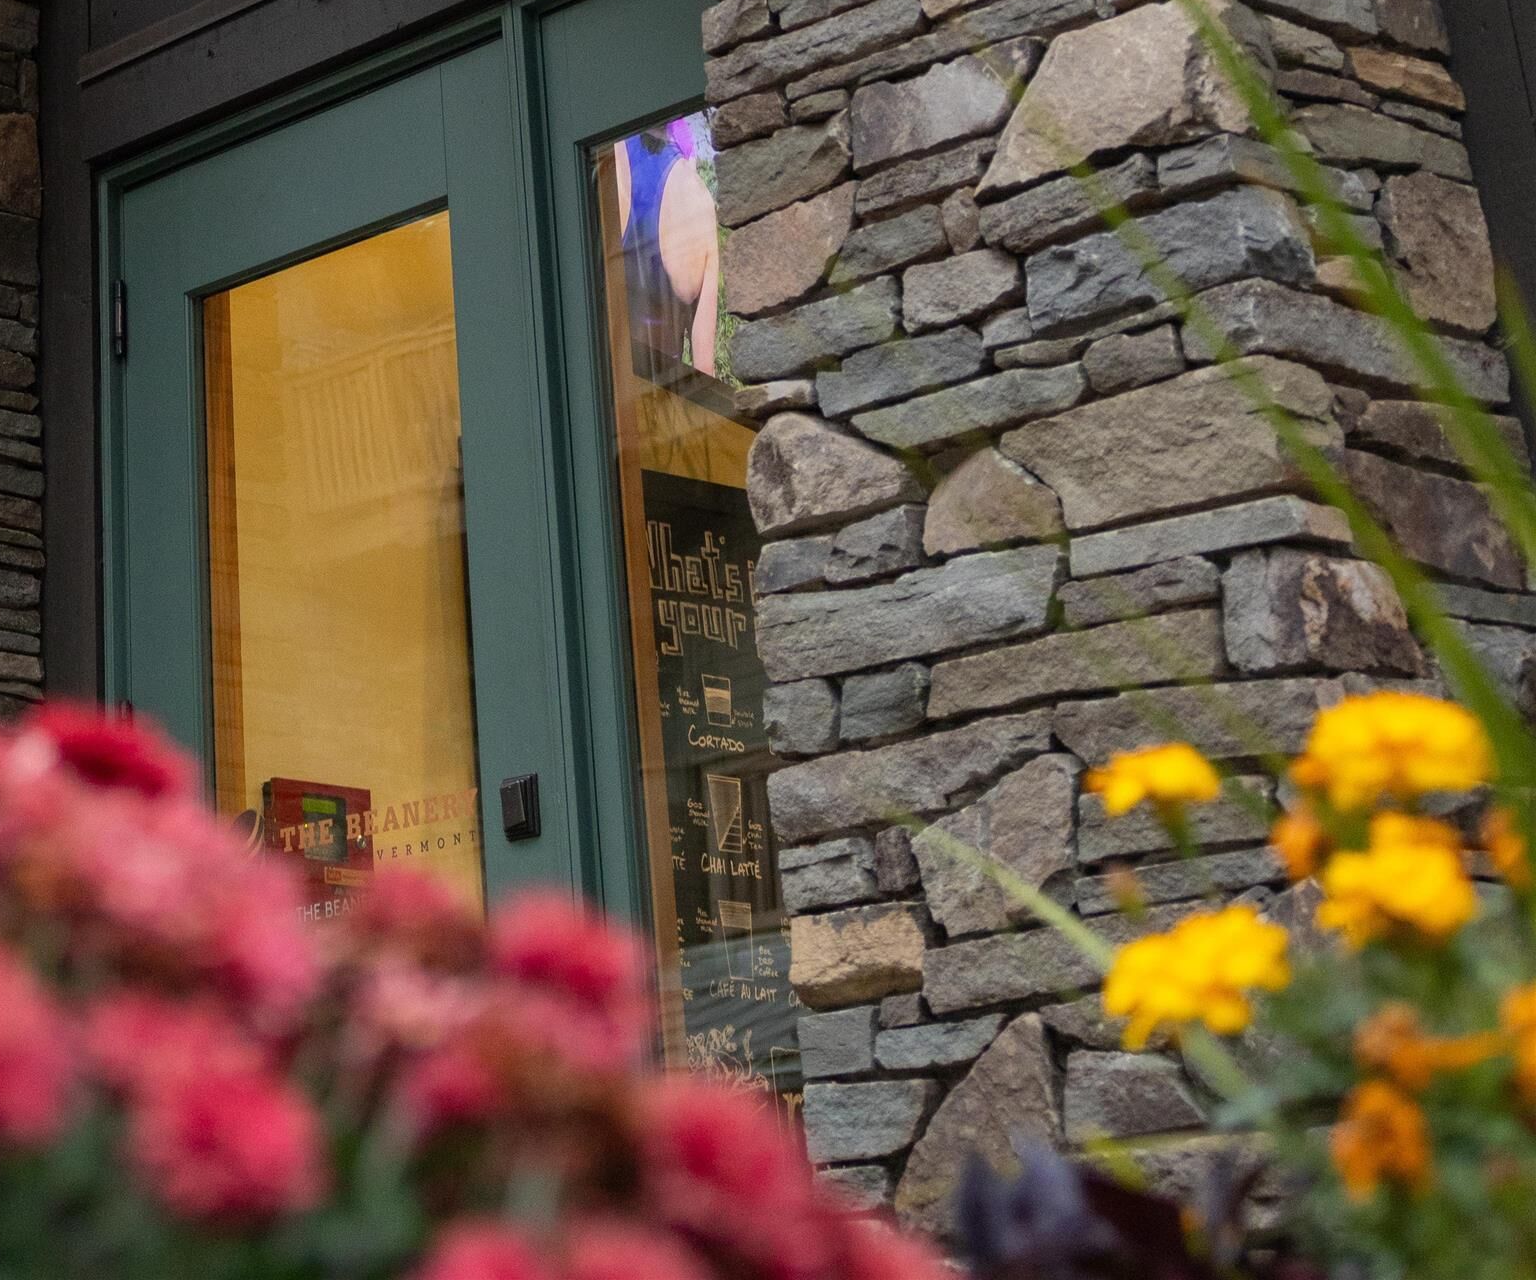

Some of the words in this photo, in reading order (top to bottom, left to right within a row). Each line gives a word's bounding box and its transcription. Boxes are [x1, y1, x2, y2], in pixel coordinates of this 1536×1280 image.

[657, 599, 746, 657] your
[280, 819, 334, 854] THE
[346, 787, 479, 841] BEANERY
[376, 830, 477, 861] VERMONT
[296, 903, 321, 923] THE
[710, 980, 735, 998] CAFÉ
